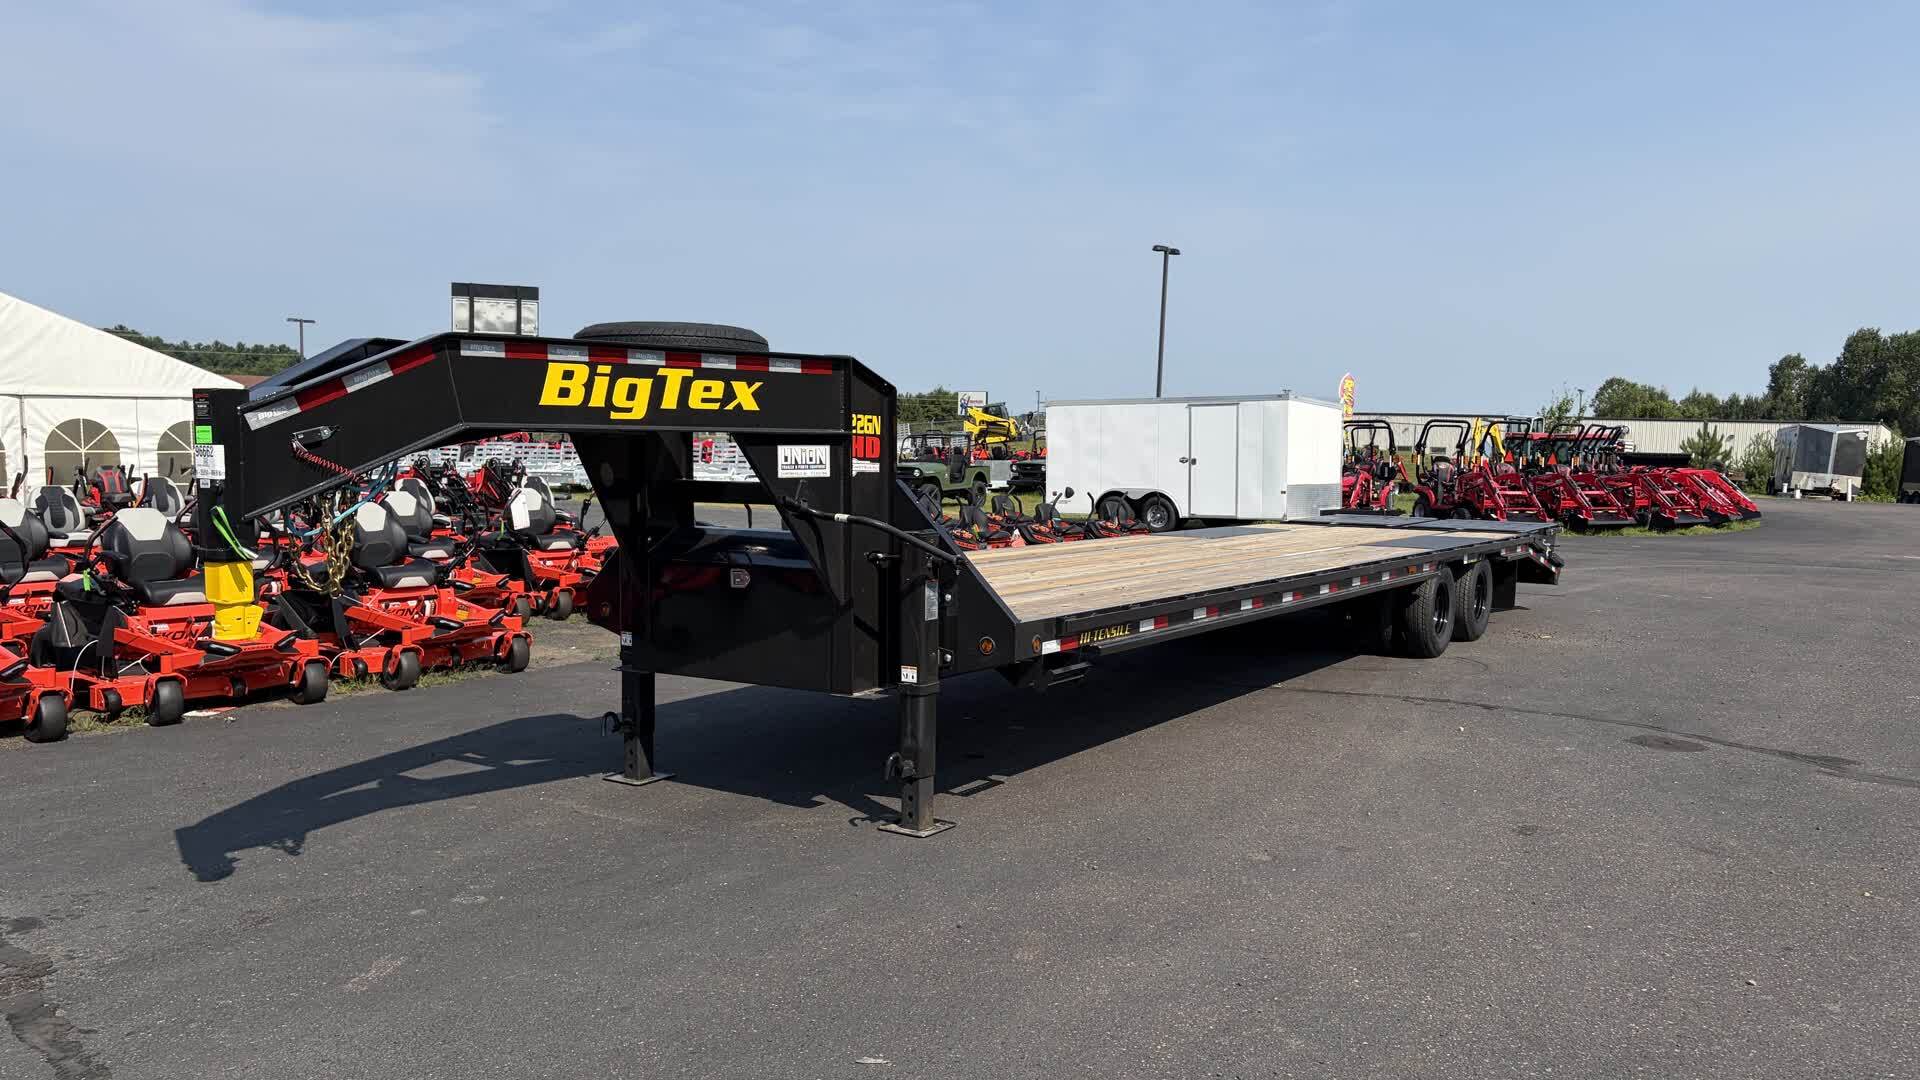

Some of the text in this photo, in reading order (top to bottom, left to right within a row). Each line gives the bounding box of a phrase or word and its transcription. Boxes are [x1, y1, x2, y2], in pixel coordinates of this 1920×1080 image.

[539, 362, 763, 420] BigTex
[852, 435, 880, 459] HD
[1079, 623, 1131, 644] HI-TENSILE
